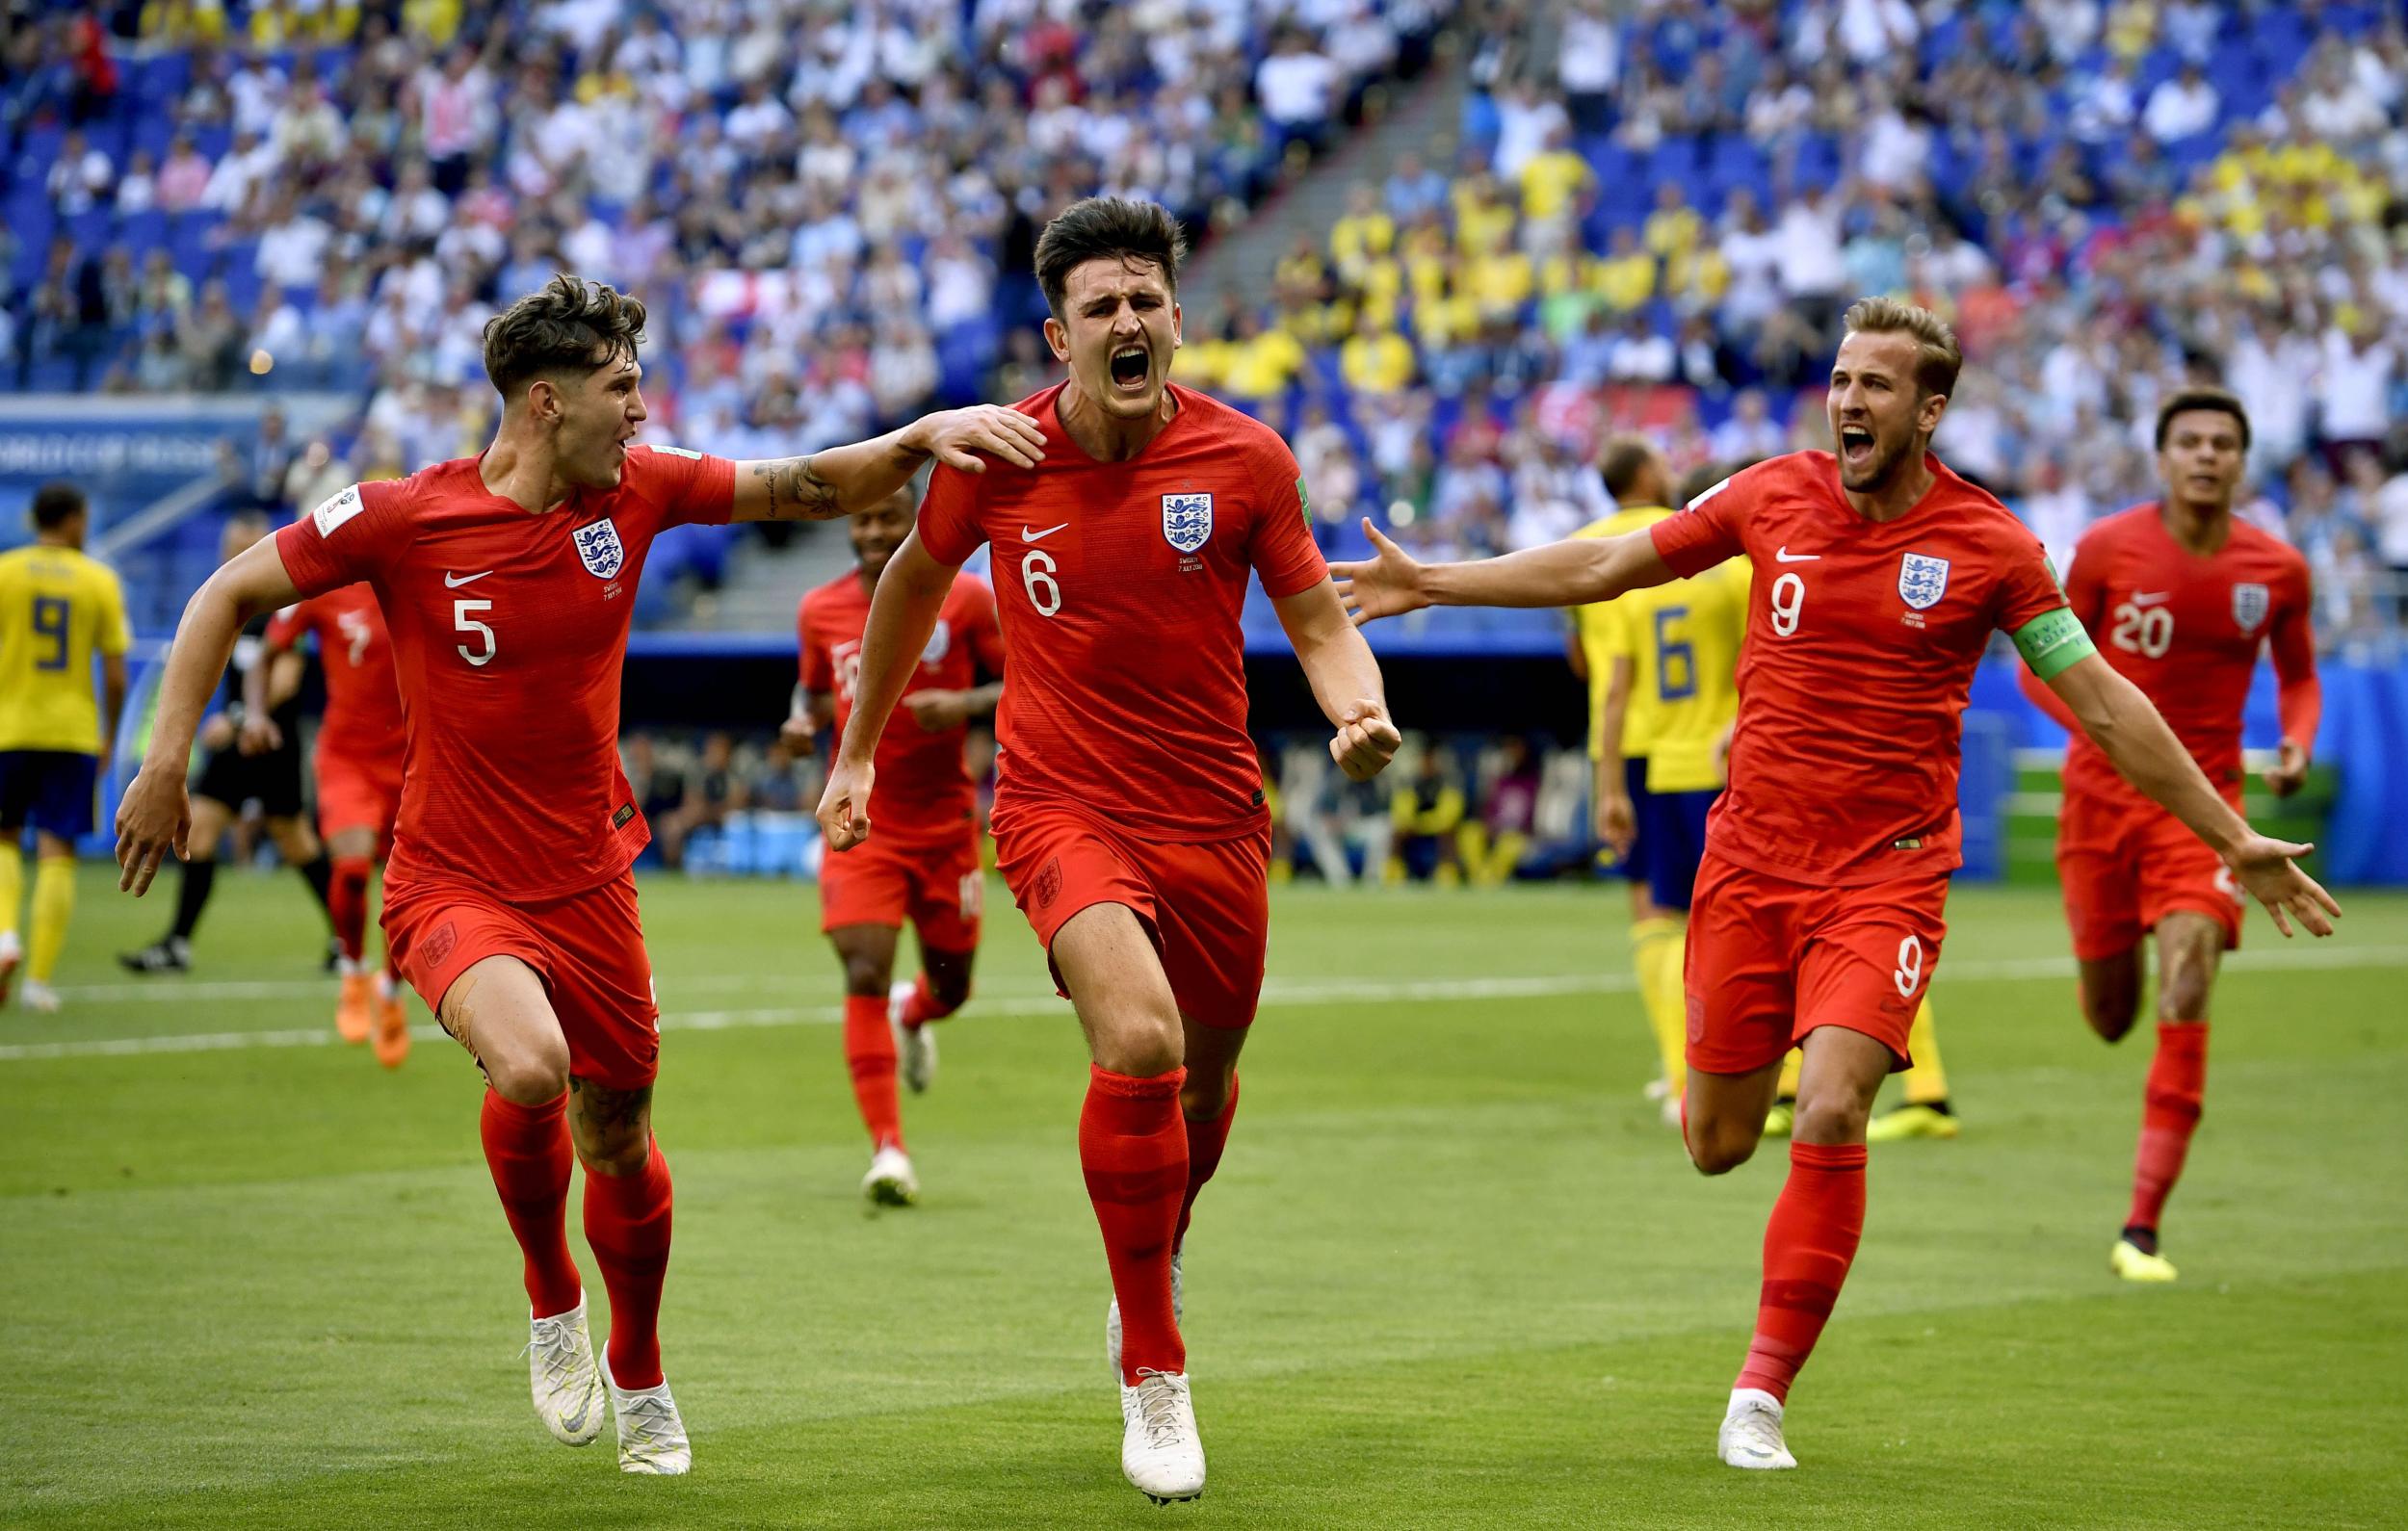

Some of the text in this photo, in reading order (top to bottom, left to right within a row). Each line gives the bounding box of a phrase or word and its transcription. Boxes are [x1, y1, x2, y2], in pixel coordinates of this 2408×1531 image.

[1022, 550, 1061, 617] 6
[1771, 572, 1806, 637] 9
[33, 594, 69, 671] 9
[342, 623, 372, 667] 7
[454, 600, 496, 666] 5
[1655, 606, 1695, 701] 6
[2111, 603, 2174, 660] 20
[1894, 934, 1923, 998] 9
